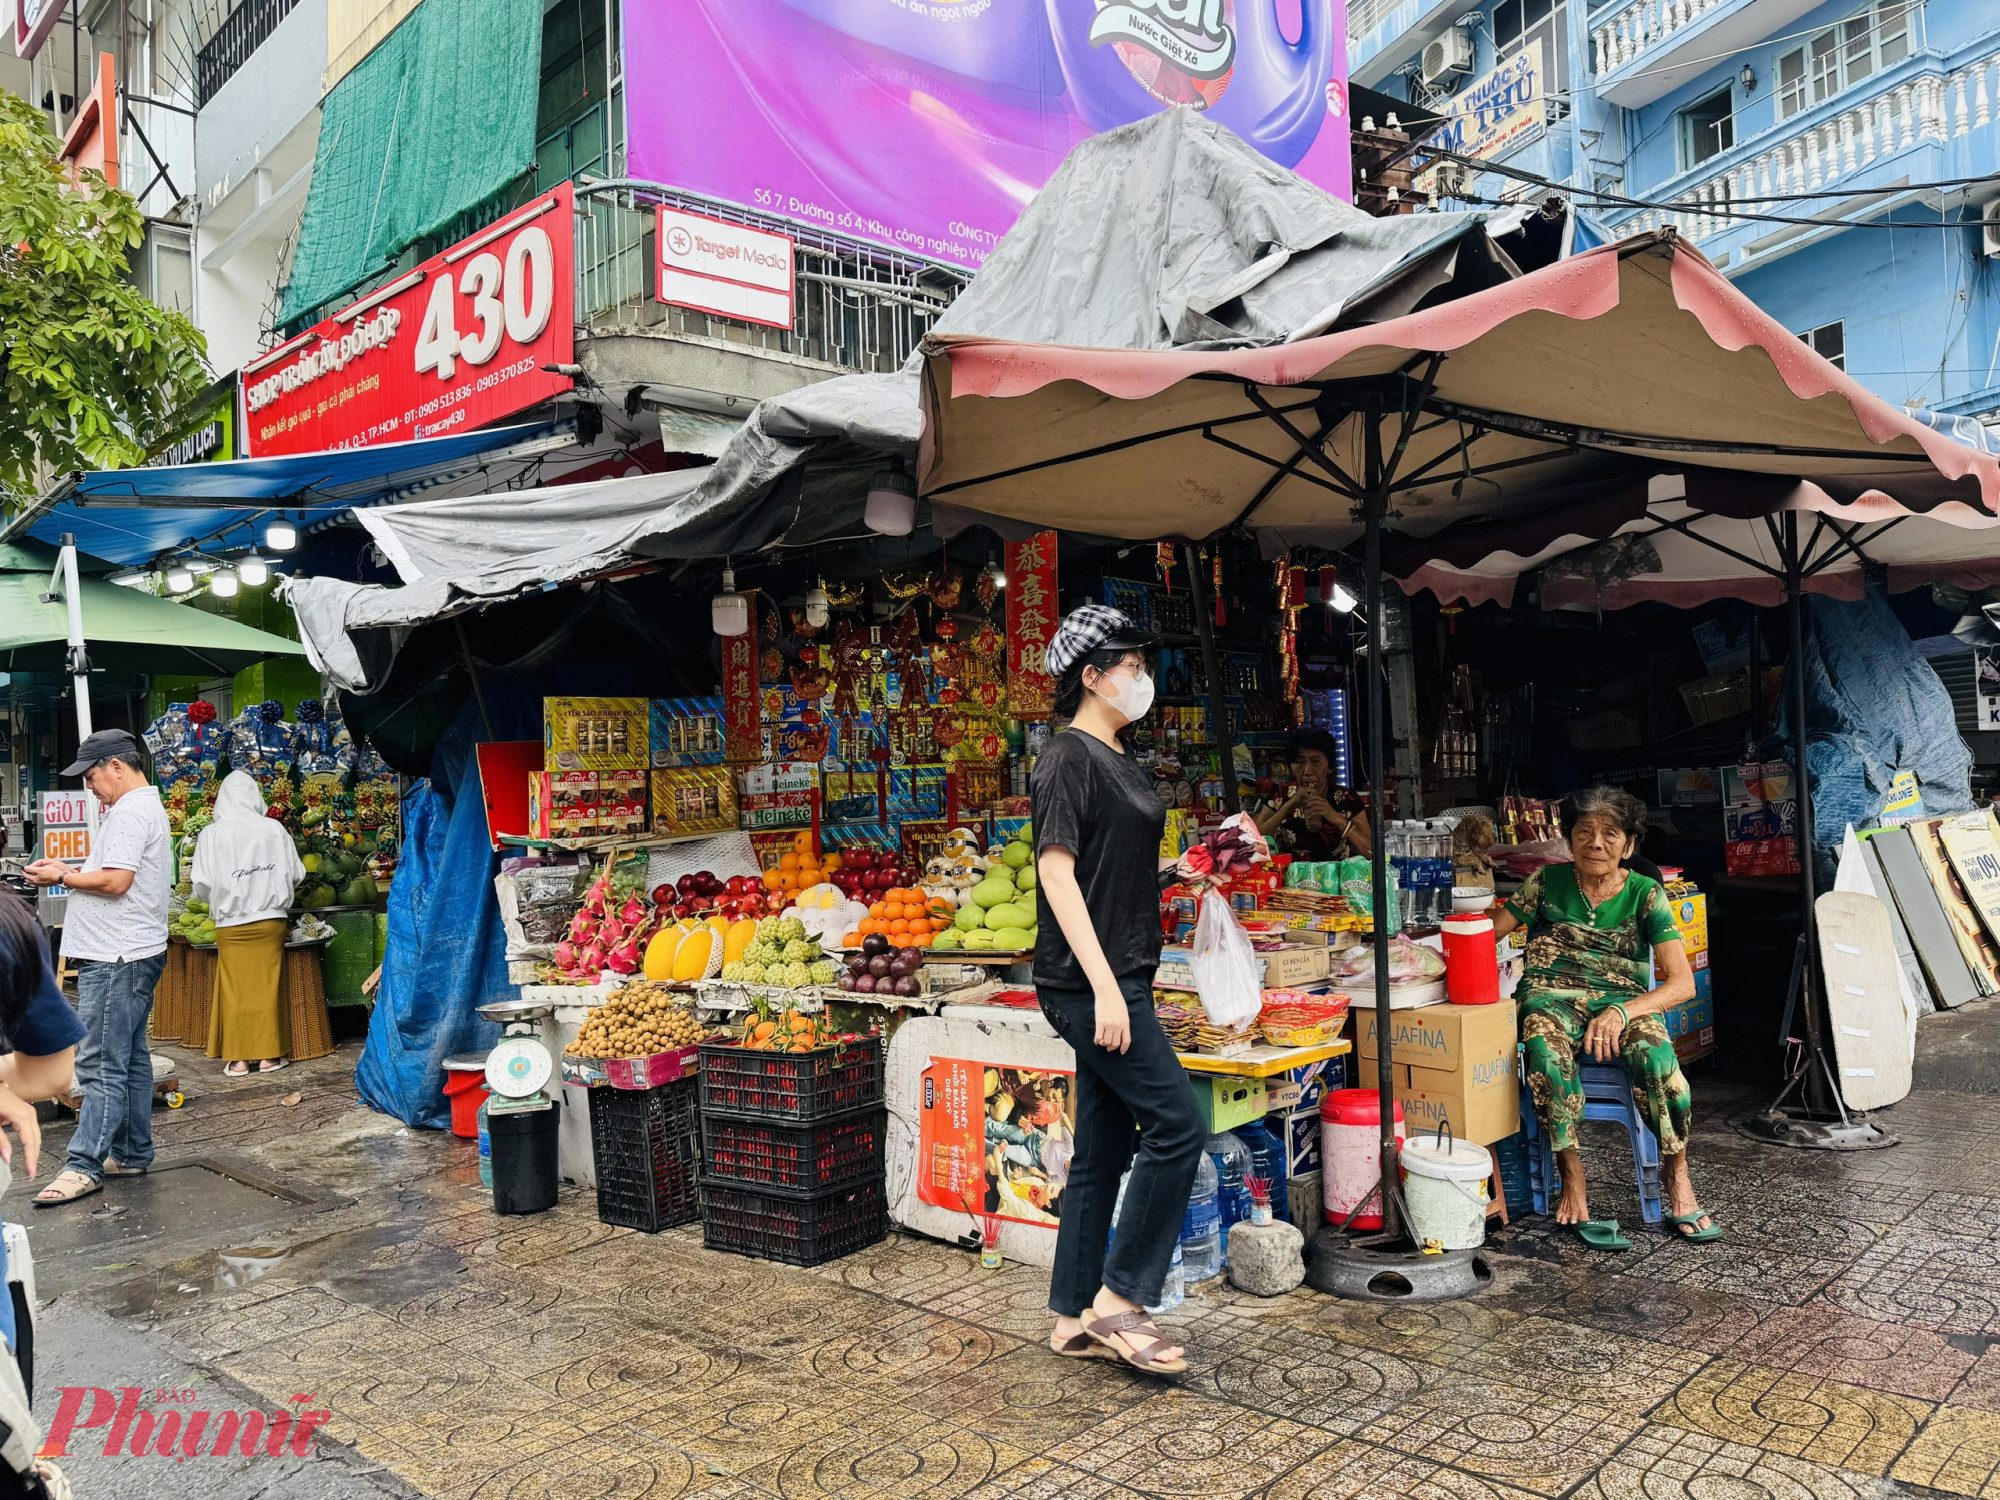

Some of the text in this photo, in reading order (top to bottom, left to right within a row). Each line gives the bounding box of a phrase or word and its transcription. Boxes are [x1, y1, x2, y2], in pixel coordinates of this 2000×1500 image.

[1128, 14, 1158, 41] Nước
[1160, 34, 1182, 59] Giặt
[1184, 49, 1199, 66] Xả
[1464, 64, 1513, 112] THUỐC
[754, 187, 990, 263] Số 7, Đường số 4, Khu công nghiệp Việ
[949, 221, 999, 246] CÔNG TY
[694, 234, 787, 271] Target Media
[414, 226, 555, 381] 430
[247, 373, 281, 413] SHOP
[280, 350, 313, 393] TRÁI
[341, 315, 366, 363] ĐỒ
[364, 306, 401, 350] HỘP
[299, 404, 312, 425] quà
[328, 390, 339, 409] cả
[339, 384, 355, 407] phải
[368, 420, 399, 440] TP.HCM
[404, 411, 418, 426] ĐT:
[418, 398, 439, 419] 0909
[439, 392, 456, 411] 513
[455, 383, 472, 405] 836
[477, 372, 499, 393] 0903
[499, 364, 517, 384] 370
[516, 355, 535, 376] 825
[1015, 540, 1050, 677] 恭喜發財
[559, 774, 594, 789] Sweet TAMARIND
[608, 772, 641, 787] Sweet TAMARIND
[558, 811, 592, 826] Sweet TAMARIND
[606, 808, 639, 823] Sweet TAMARIND
[1471, 1049, 1515, 1090] AQUAFINA
